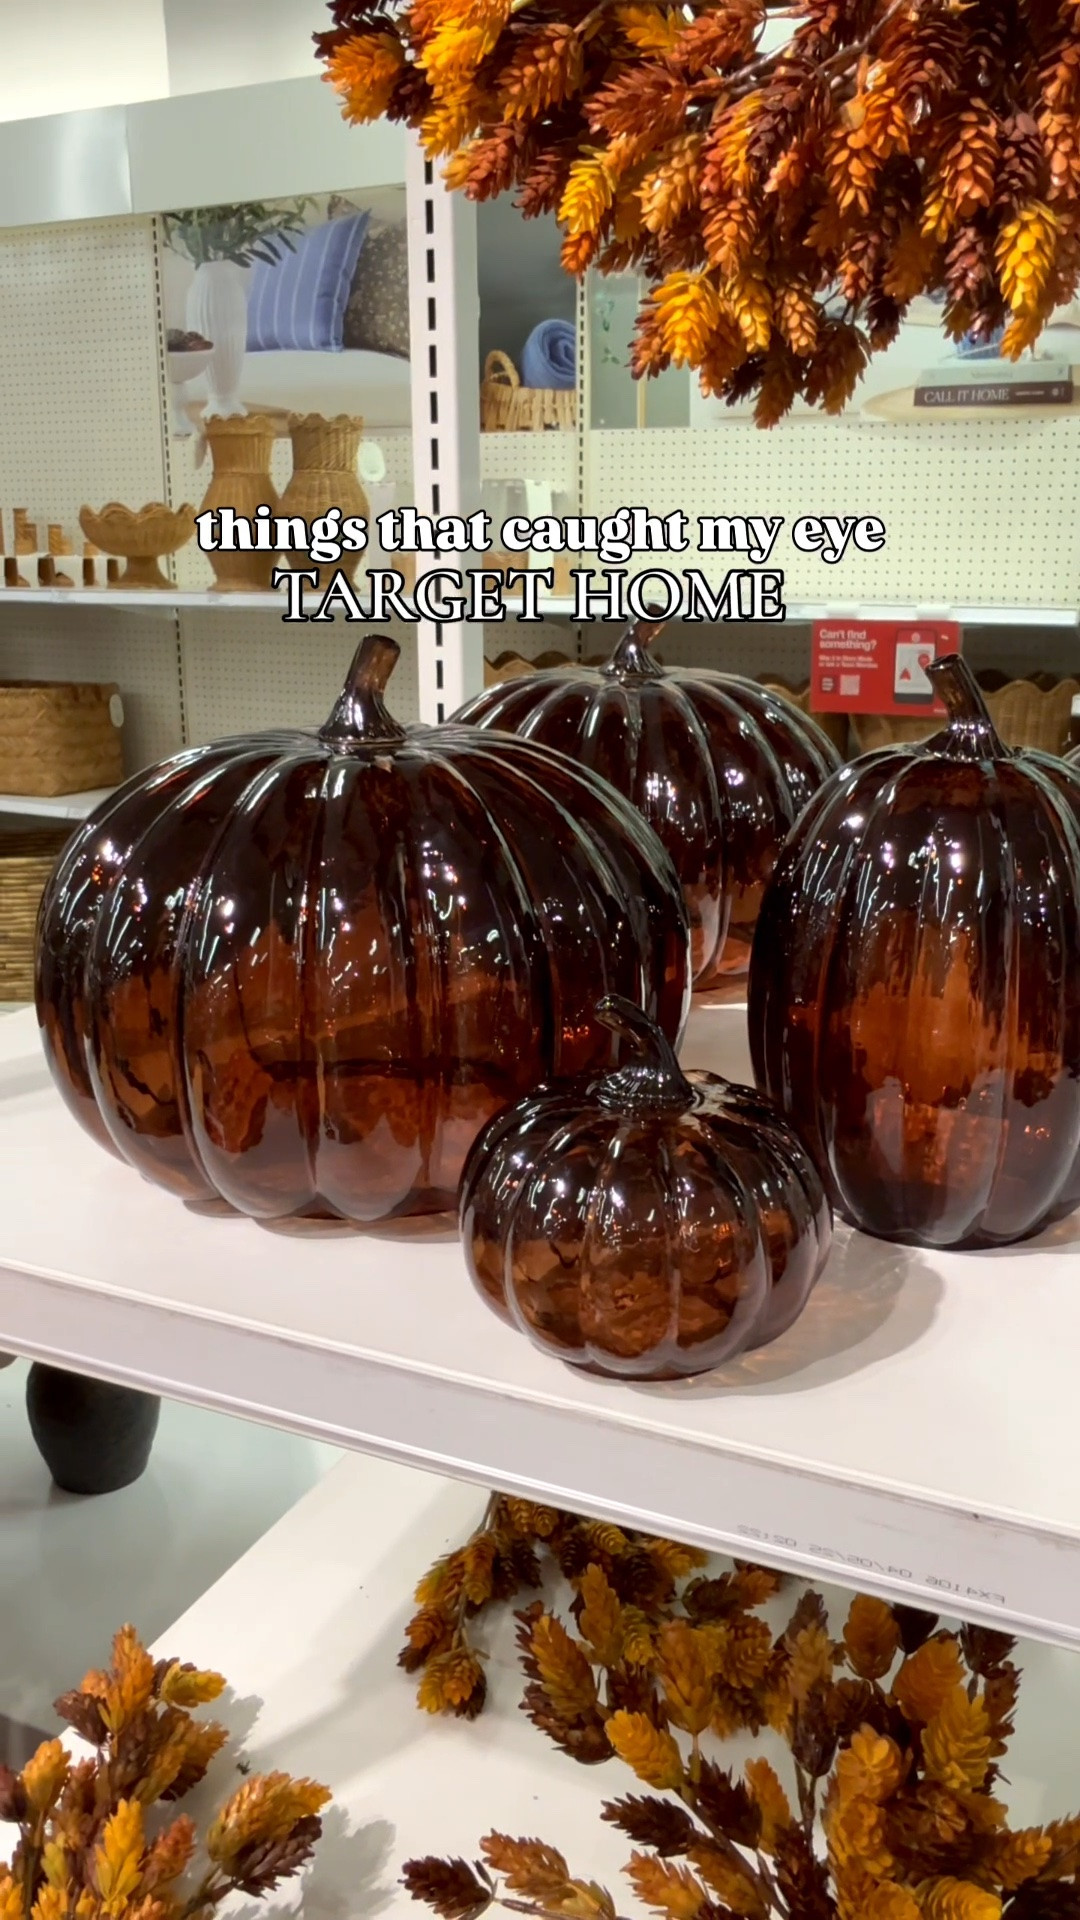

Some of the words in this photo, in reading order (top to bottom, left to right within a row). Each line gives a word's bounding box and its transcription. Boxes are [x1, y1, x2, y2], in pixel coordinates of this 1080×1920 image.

[923, 390, 953, 403] CALL
[956, 389, 971, 402] IT
[971, 388, 1010, 401] HOME
[819, 629, 846, 640] Can't
[847, 629, 867, 640] find
[819, 640, 877, 651] something?
